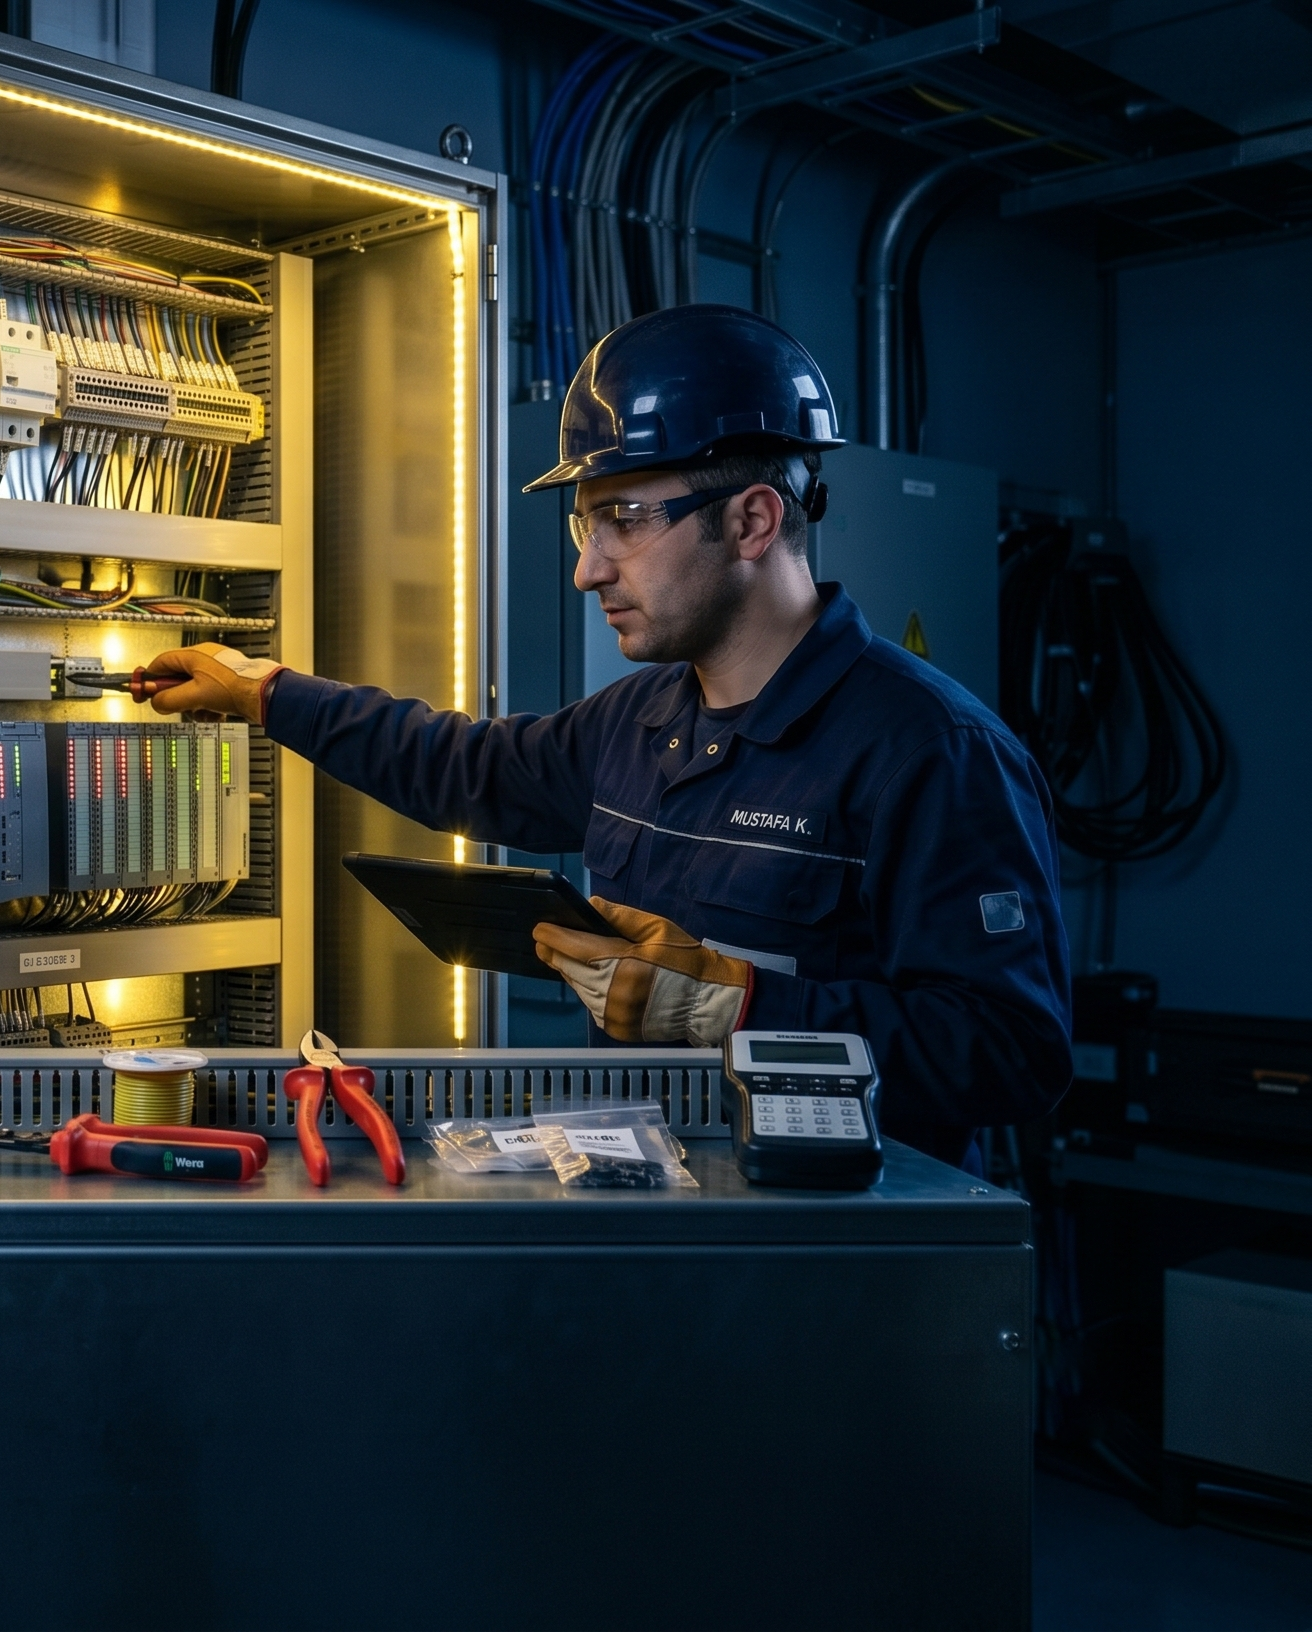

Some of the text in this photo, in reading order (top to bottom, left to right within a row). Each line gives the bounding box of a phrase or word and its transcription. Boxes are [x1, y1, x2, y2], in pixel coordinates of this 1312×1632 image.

[730, 809, 812, 835] MUSTAFA K.
[175, 1156, 204, 1168] Wera
